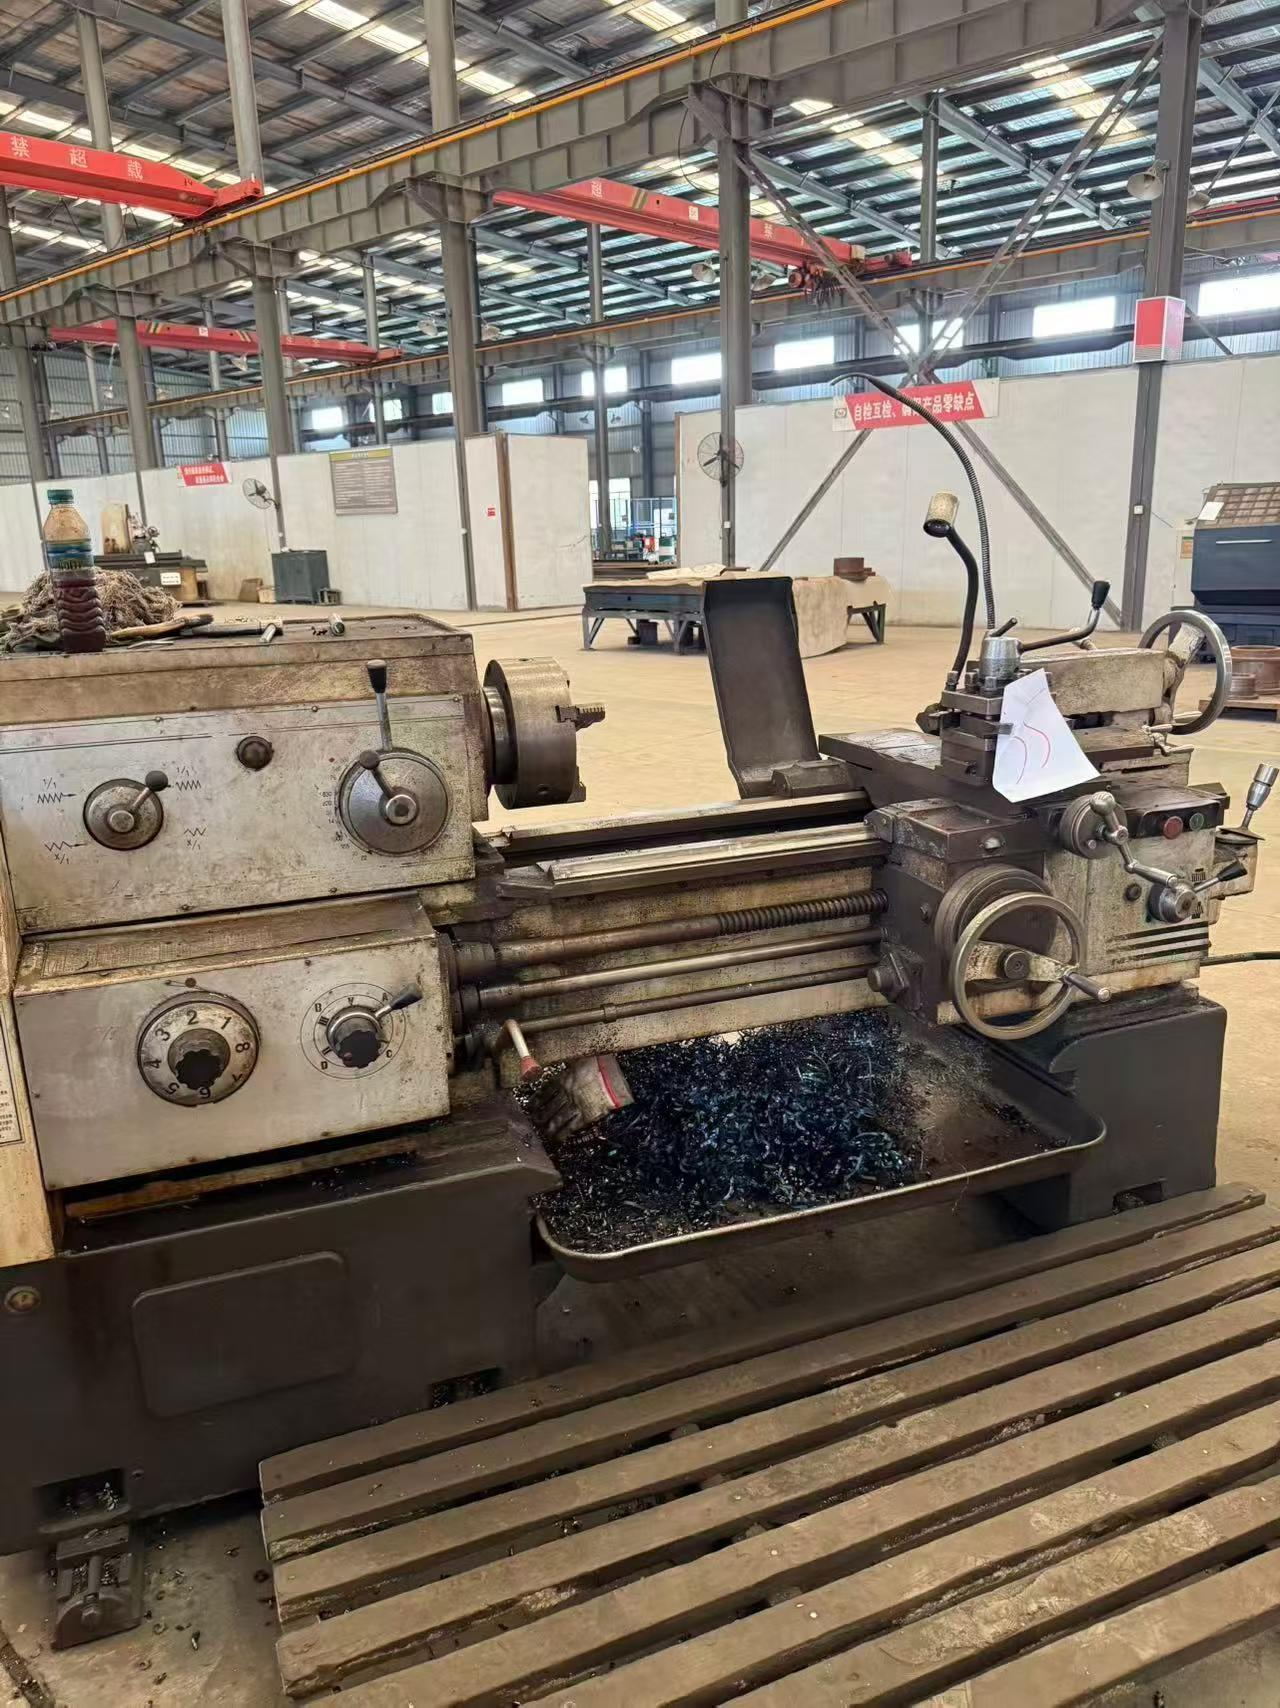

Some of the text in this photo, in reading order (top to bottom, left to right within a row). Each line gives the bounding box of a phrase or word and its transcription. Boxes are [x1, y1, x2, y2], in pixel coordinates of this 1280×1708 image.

[186, 1009, 200, 1026] 2
[220, 1016, 232, 1030] 1
[154, 1027, 171, 1042] 3
[235, 1041, 251, 1054] 8
[144, 1058, 162, 1069] 4
[164, 1082, 180, 1096] 5
